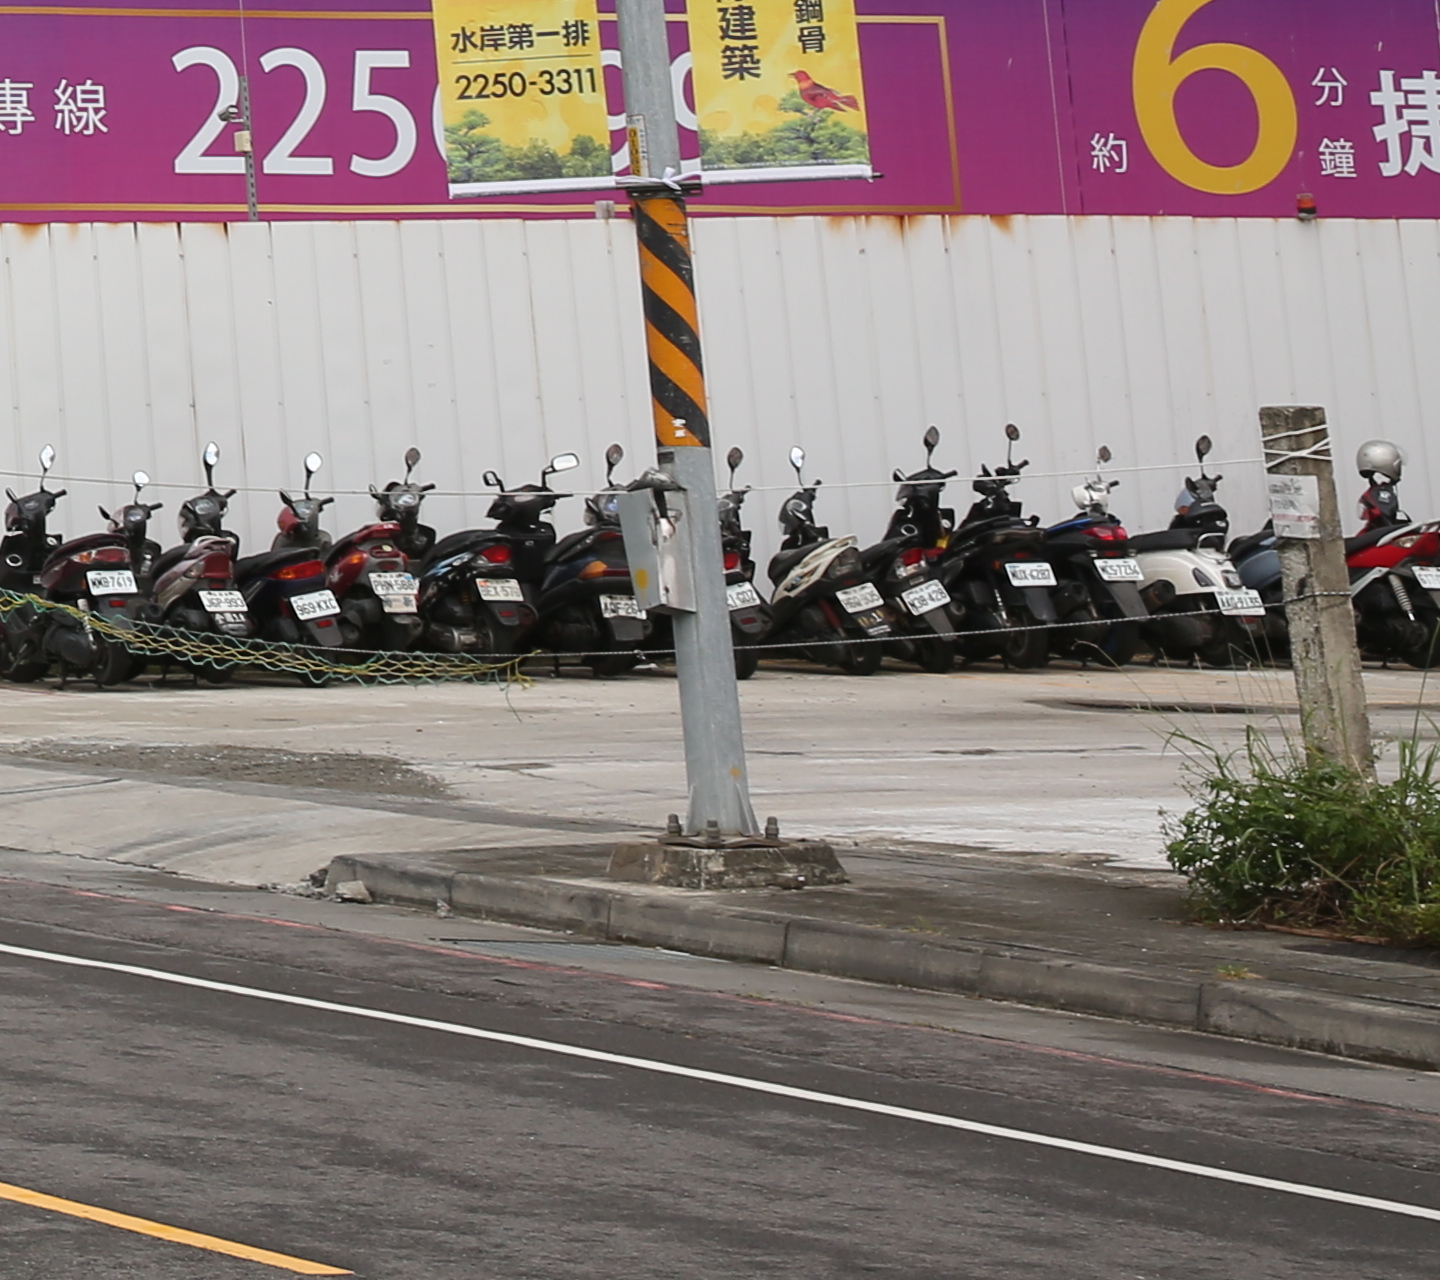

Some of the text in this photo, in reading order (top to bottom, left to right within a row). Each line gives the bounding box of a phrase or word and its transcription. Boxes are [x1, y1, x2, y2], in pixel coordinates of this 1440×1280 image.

[450, 19, 591, 54] 水岸第一排
[454, 67, 598, 102] 2250-3311
